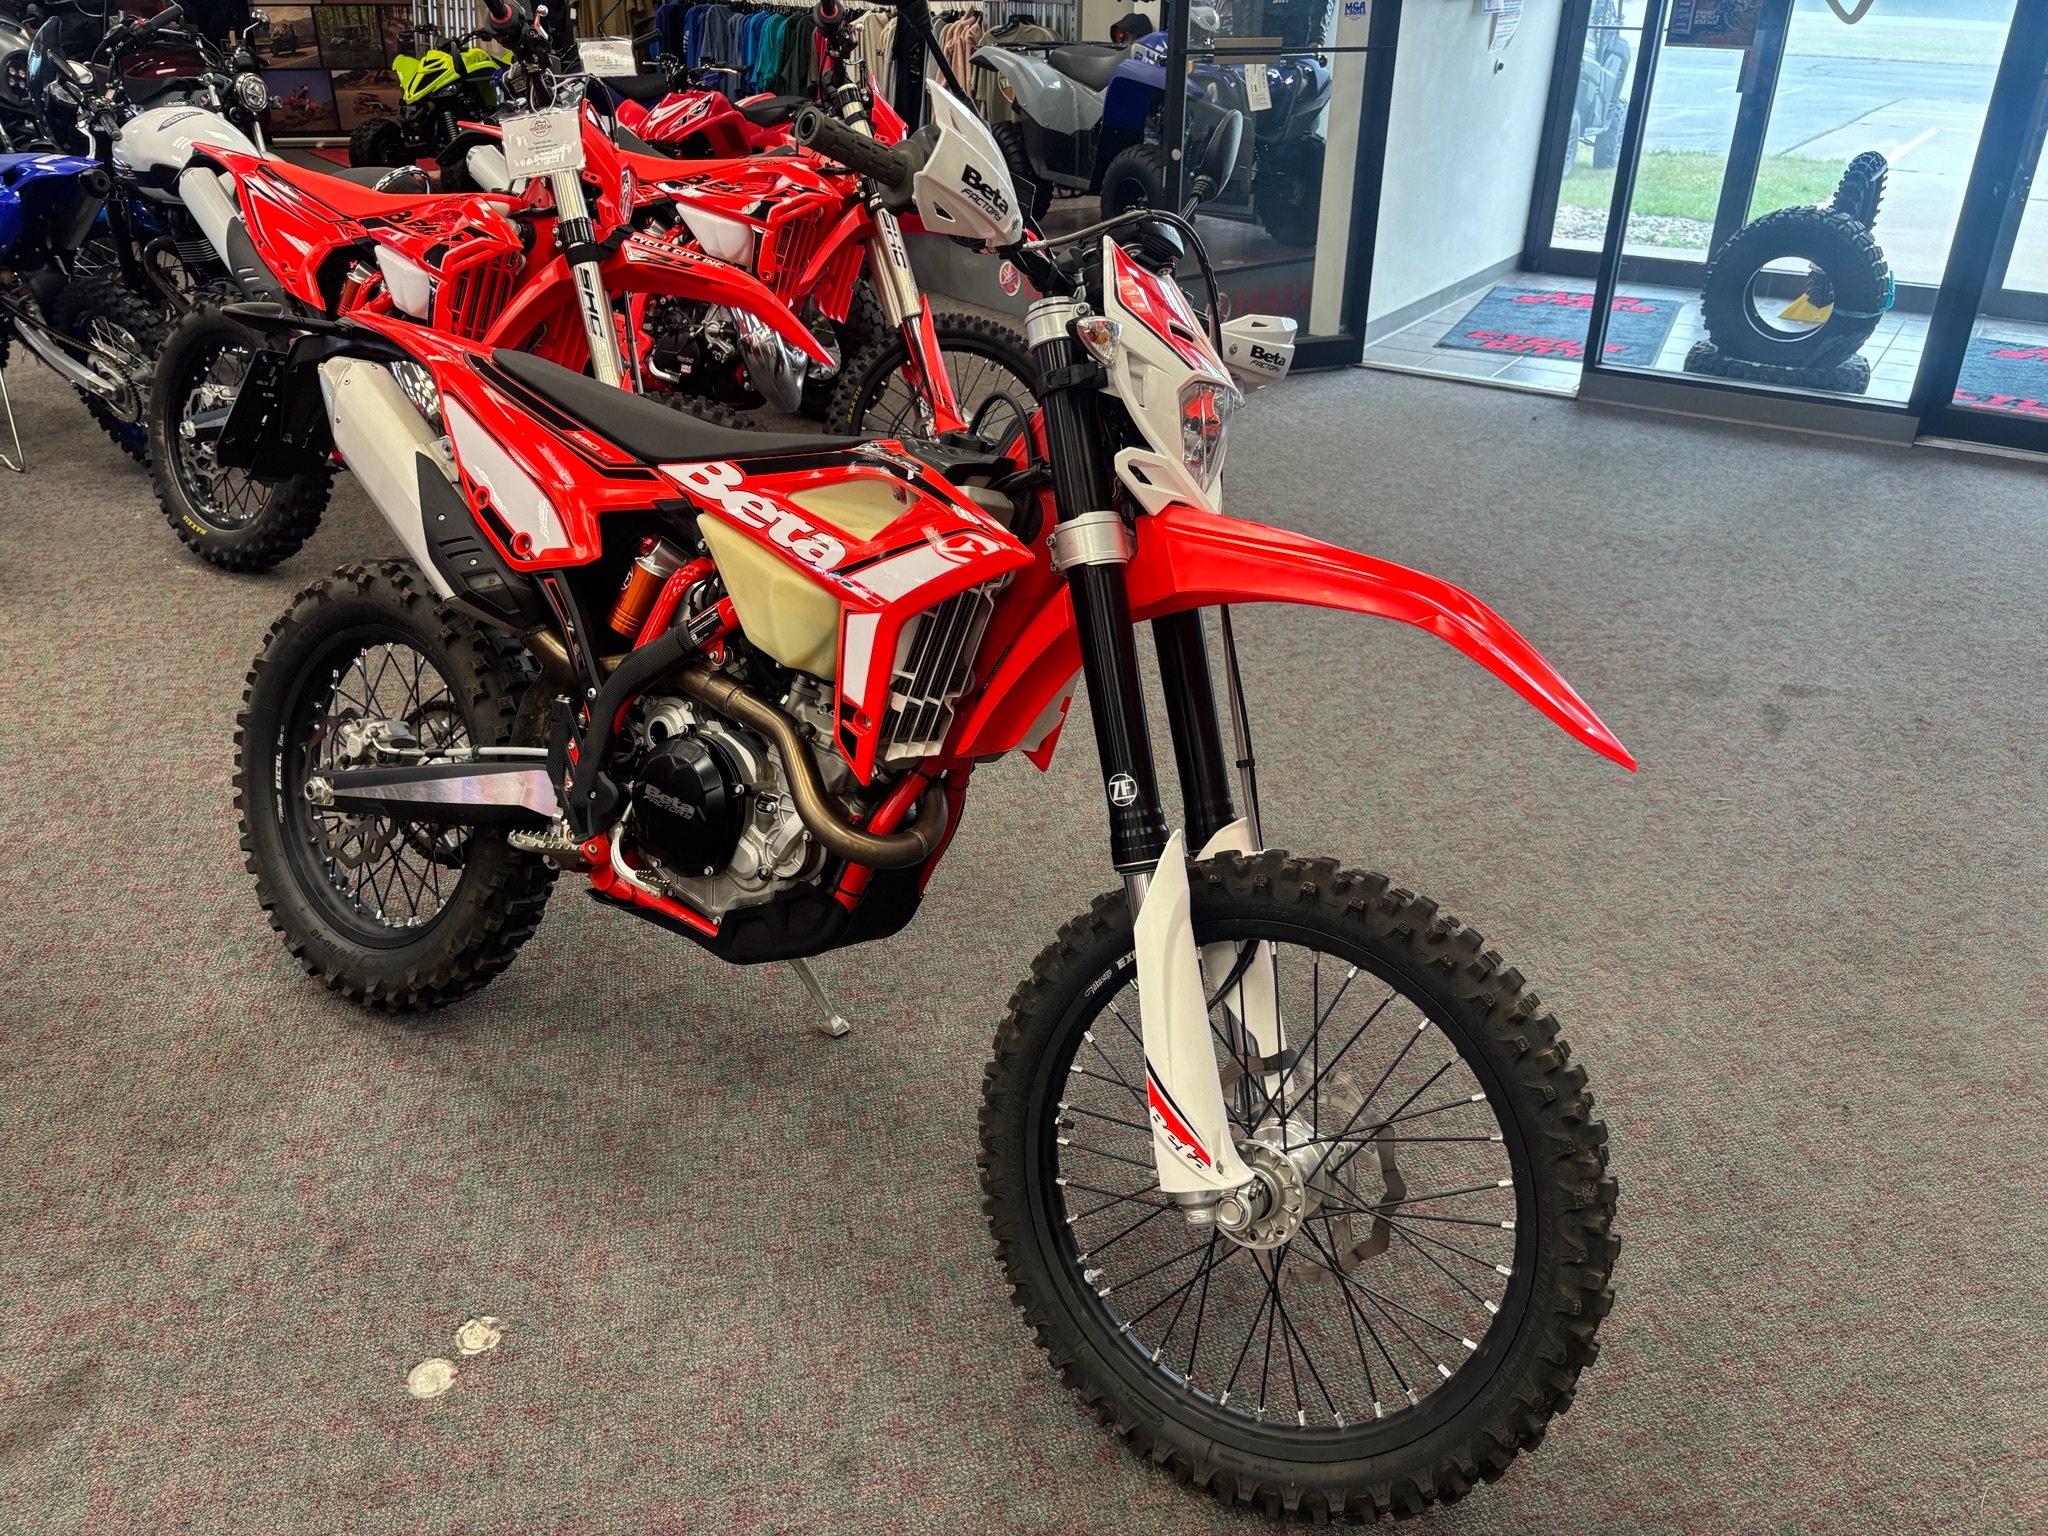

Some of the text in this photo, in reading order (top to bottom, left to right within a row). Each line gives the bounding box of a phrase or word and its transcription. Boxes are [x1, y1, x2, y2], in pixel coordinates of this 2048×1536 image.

[961, 164, 1009, 216] Beta
[961, 188, 1003, 222] FACTORY
[629, 235, 726, 269] CYCLE CITY INC
[1233, 282, 1312, 315] YAMAH
[1249, 344, 1287, 367] Beta
[1249, 359, 1283, 373] FACTORY
[846, 385, 863, 424] MAXXIS
[569, 431, 602, 451] 390
[658, 461, 847, 570] Beta
[274, 752, 283, 791] EXCEL
[644, 783, 696, 816] Beta
[1109, 778, 1137, 801] ZF
[643, 794, 695, 820] FACTORY
